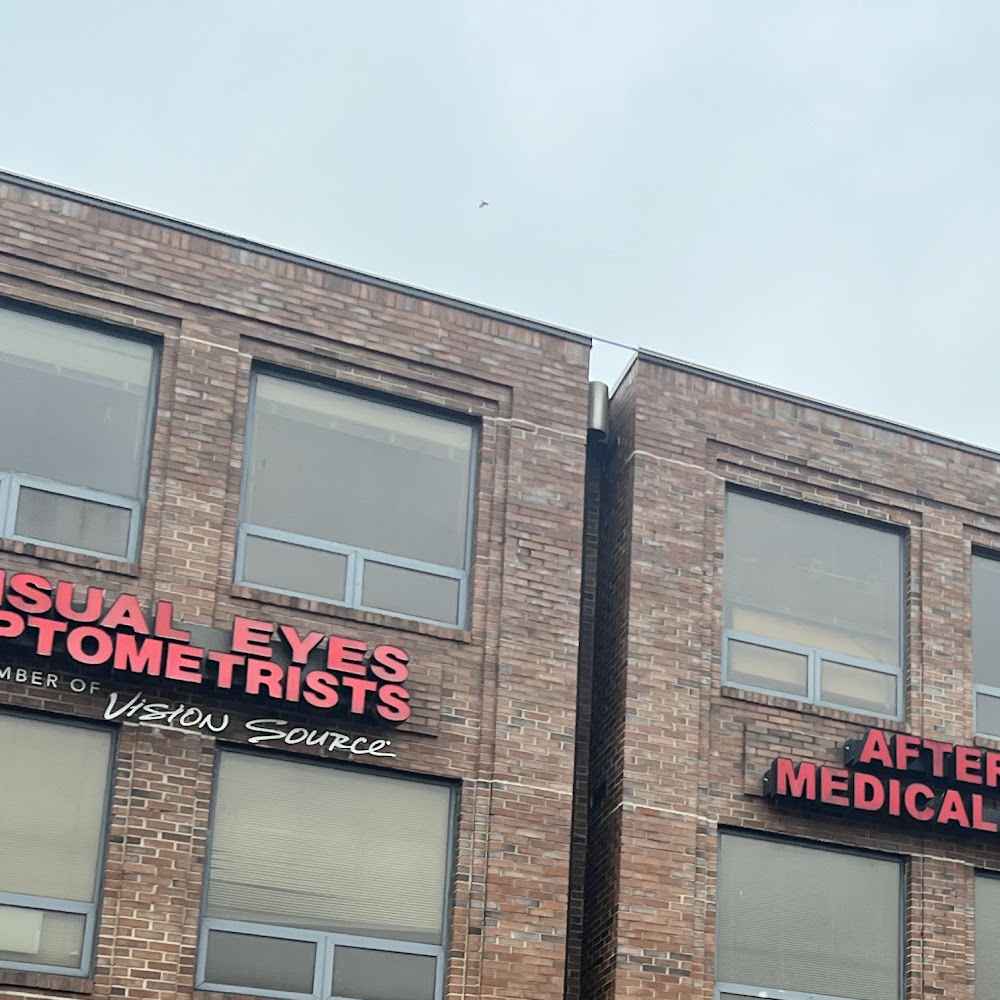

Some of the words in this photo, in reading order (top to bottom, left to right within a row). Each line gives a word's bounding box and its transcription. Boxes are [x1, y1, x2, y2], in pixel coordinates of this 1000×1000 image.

[231, 615, 411, 684] EYES
[70, 678, 101, 694] OF
[775, 757, 999, 833] MEDICAL
